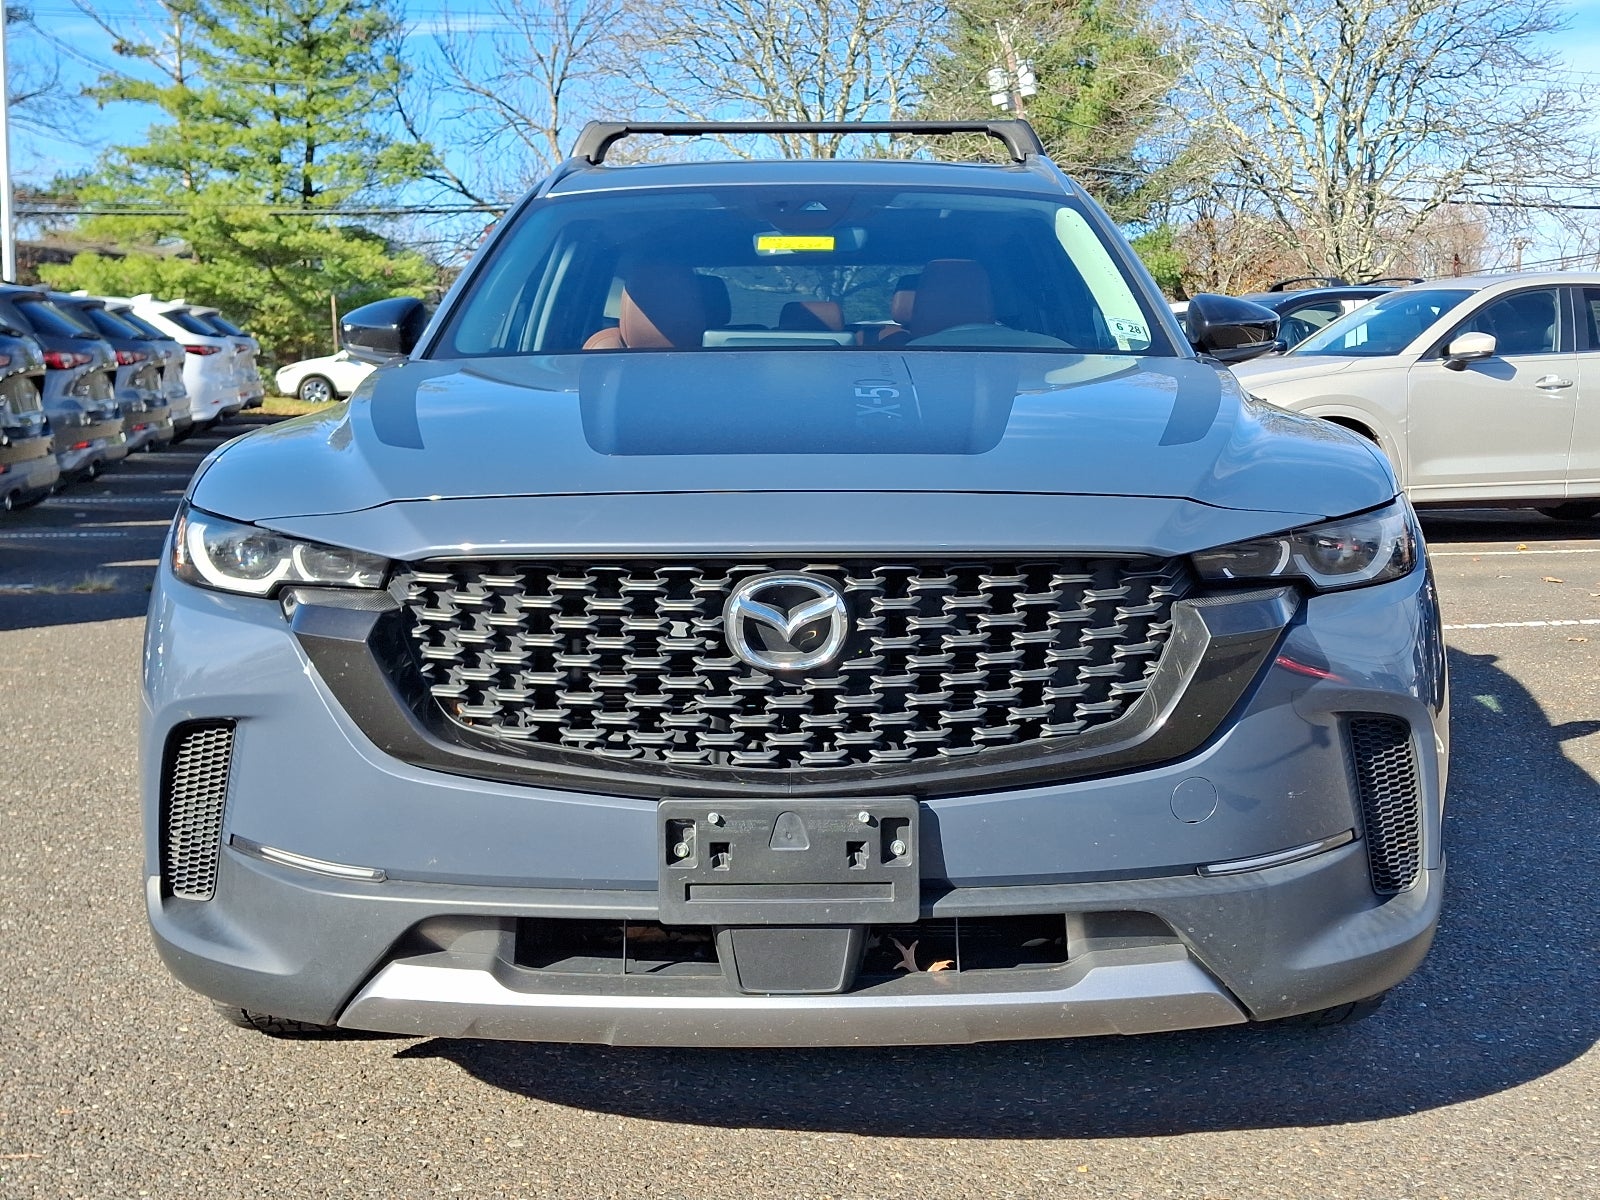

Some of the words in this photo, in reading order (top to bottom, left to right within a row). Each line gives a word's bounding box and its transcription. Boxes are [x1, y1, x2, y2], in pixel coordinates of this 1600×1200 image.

[1116, 322, 1124, 331] 6
[1128, 324, 1142, 335] 28
[853, 378, 903, 422] X-50
